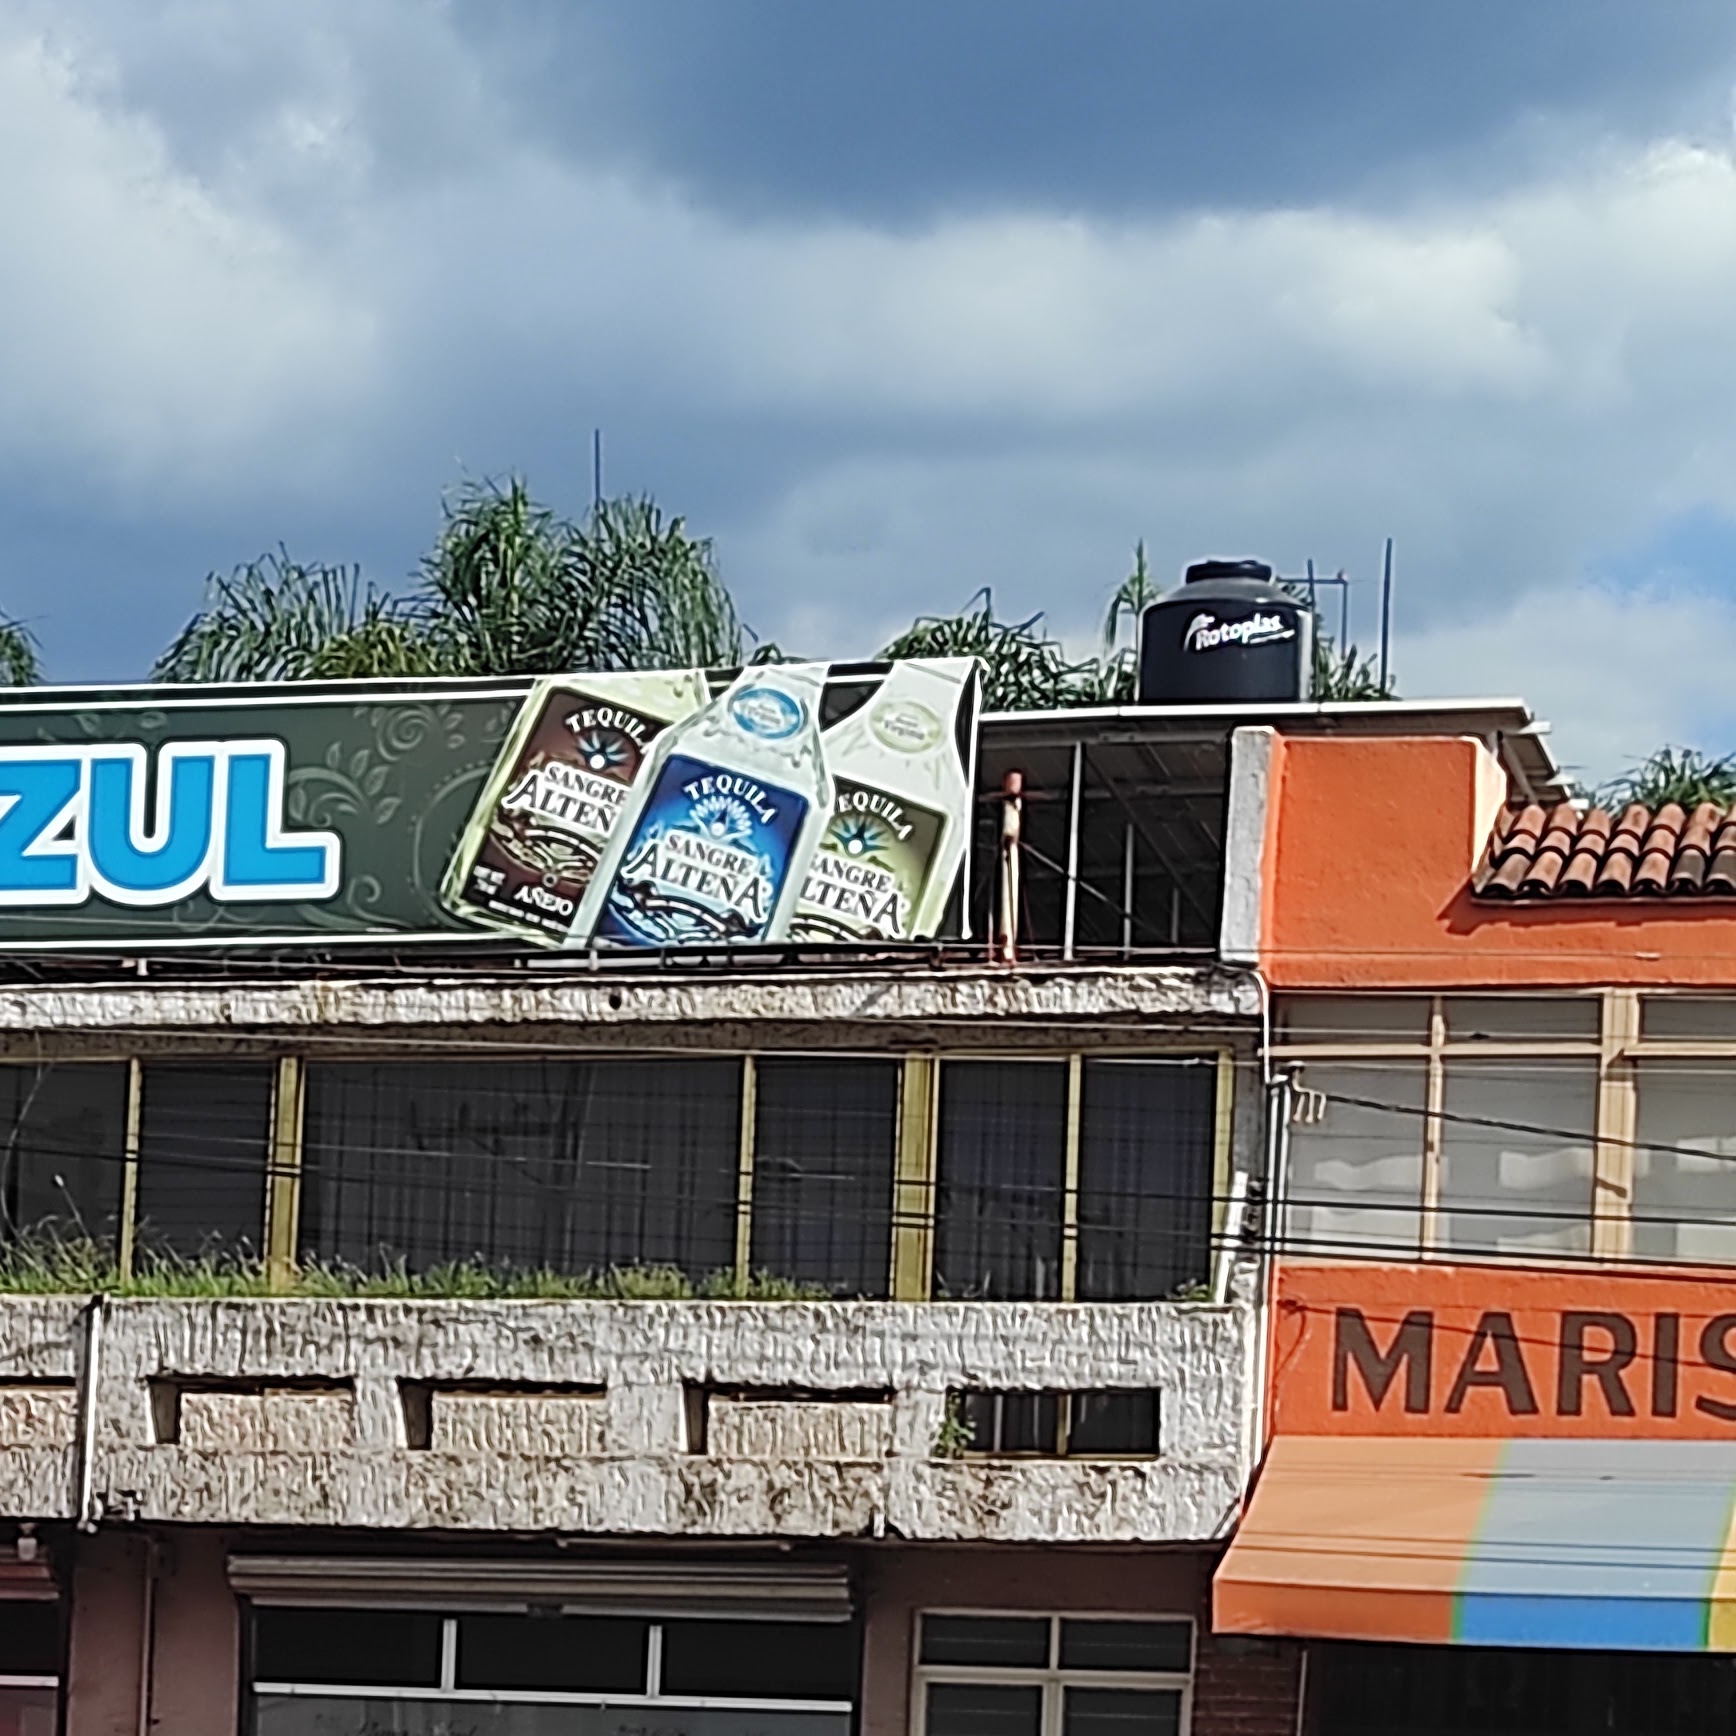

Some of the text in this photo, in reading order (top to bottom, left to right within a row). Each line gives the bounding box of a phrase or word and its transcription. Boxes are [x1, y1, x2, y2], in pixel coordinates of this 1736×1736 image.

[565, 706, 649, 754] TEQUIL
[506, 773, 618, 833] ALTEÑ
[682, 773, 778, 825] TEQUILA
[838, 790, 914, 841] EQUILA
[664, 833, 755, 878] SANGRE
[799, 874, 901, 935] LTEÑA
[1331, 1306, 1736, 1422] MARIS
